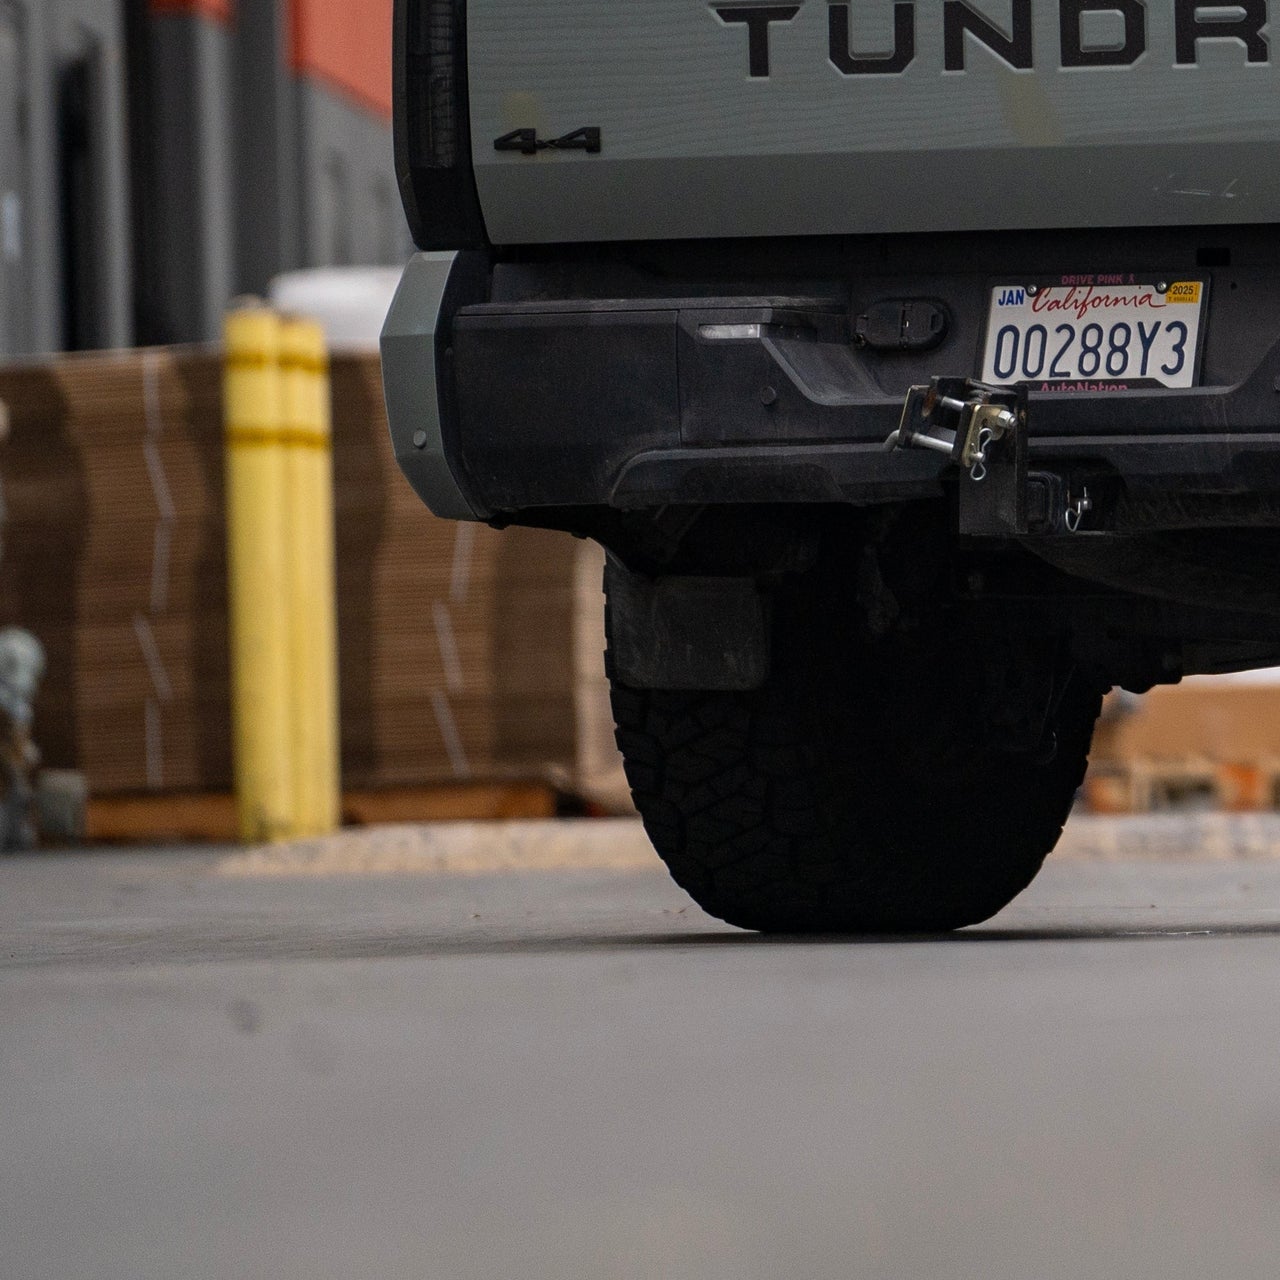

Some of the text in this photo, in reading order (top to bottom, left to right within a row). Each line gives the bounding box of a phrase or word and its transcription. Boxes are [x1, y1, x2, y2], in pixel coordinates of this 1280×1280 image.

[1061, 274, 1123, 285] DRIVE PINK
[998, 285, 1194, 320] JAN California 2025
[994, 320, 1188, 379] 00288Y3
